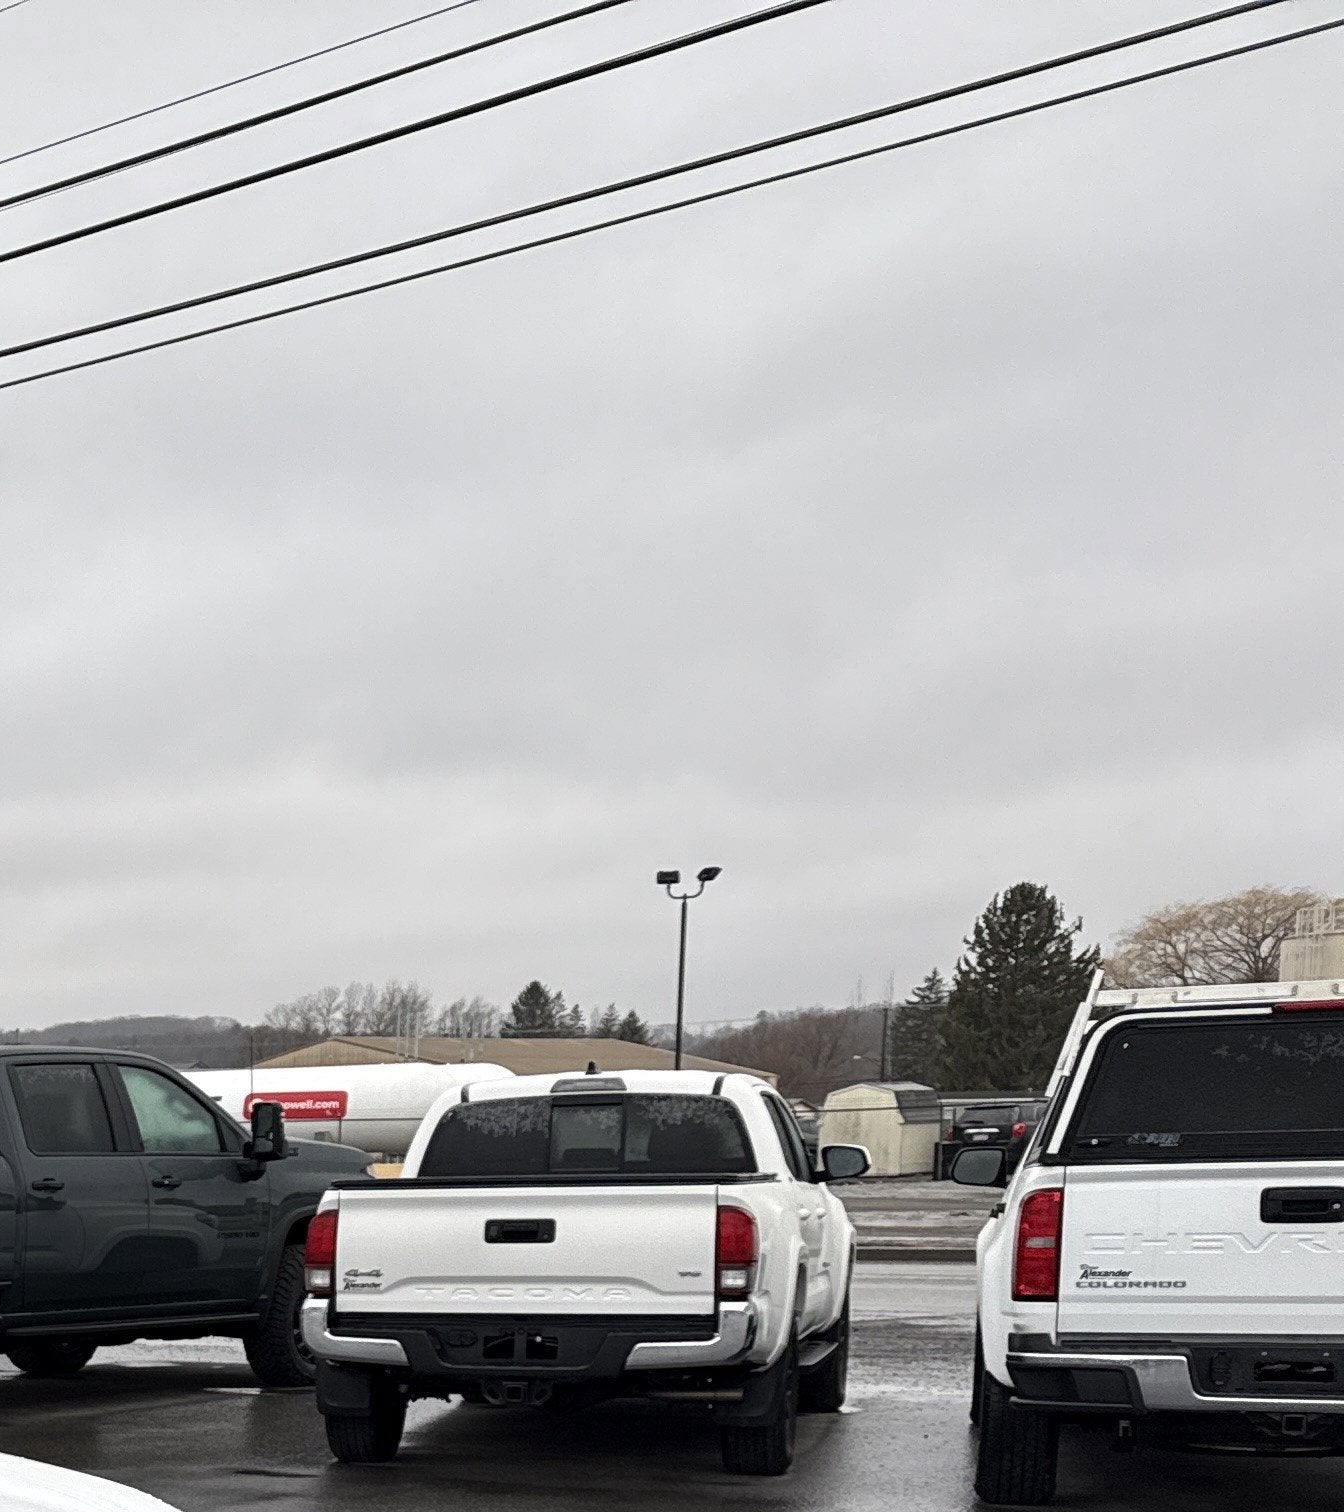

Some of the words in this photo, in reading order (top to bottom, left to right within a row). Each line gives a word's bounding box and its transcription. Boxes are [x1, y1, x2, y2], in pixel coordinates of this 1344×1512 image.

[1084, 1231, 1344, 1255] CHEVR
[1079, 1269, 1133, 1279] Alexander
[1075, 1281, 1187, 1289] COLORADO
[413, 1287, 632, 1300] TACOMA
